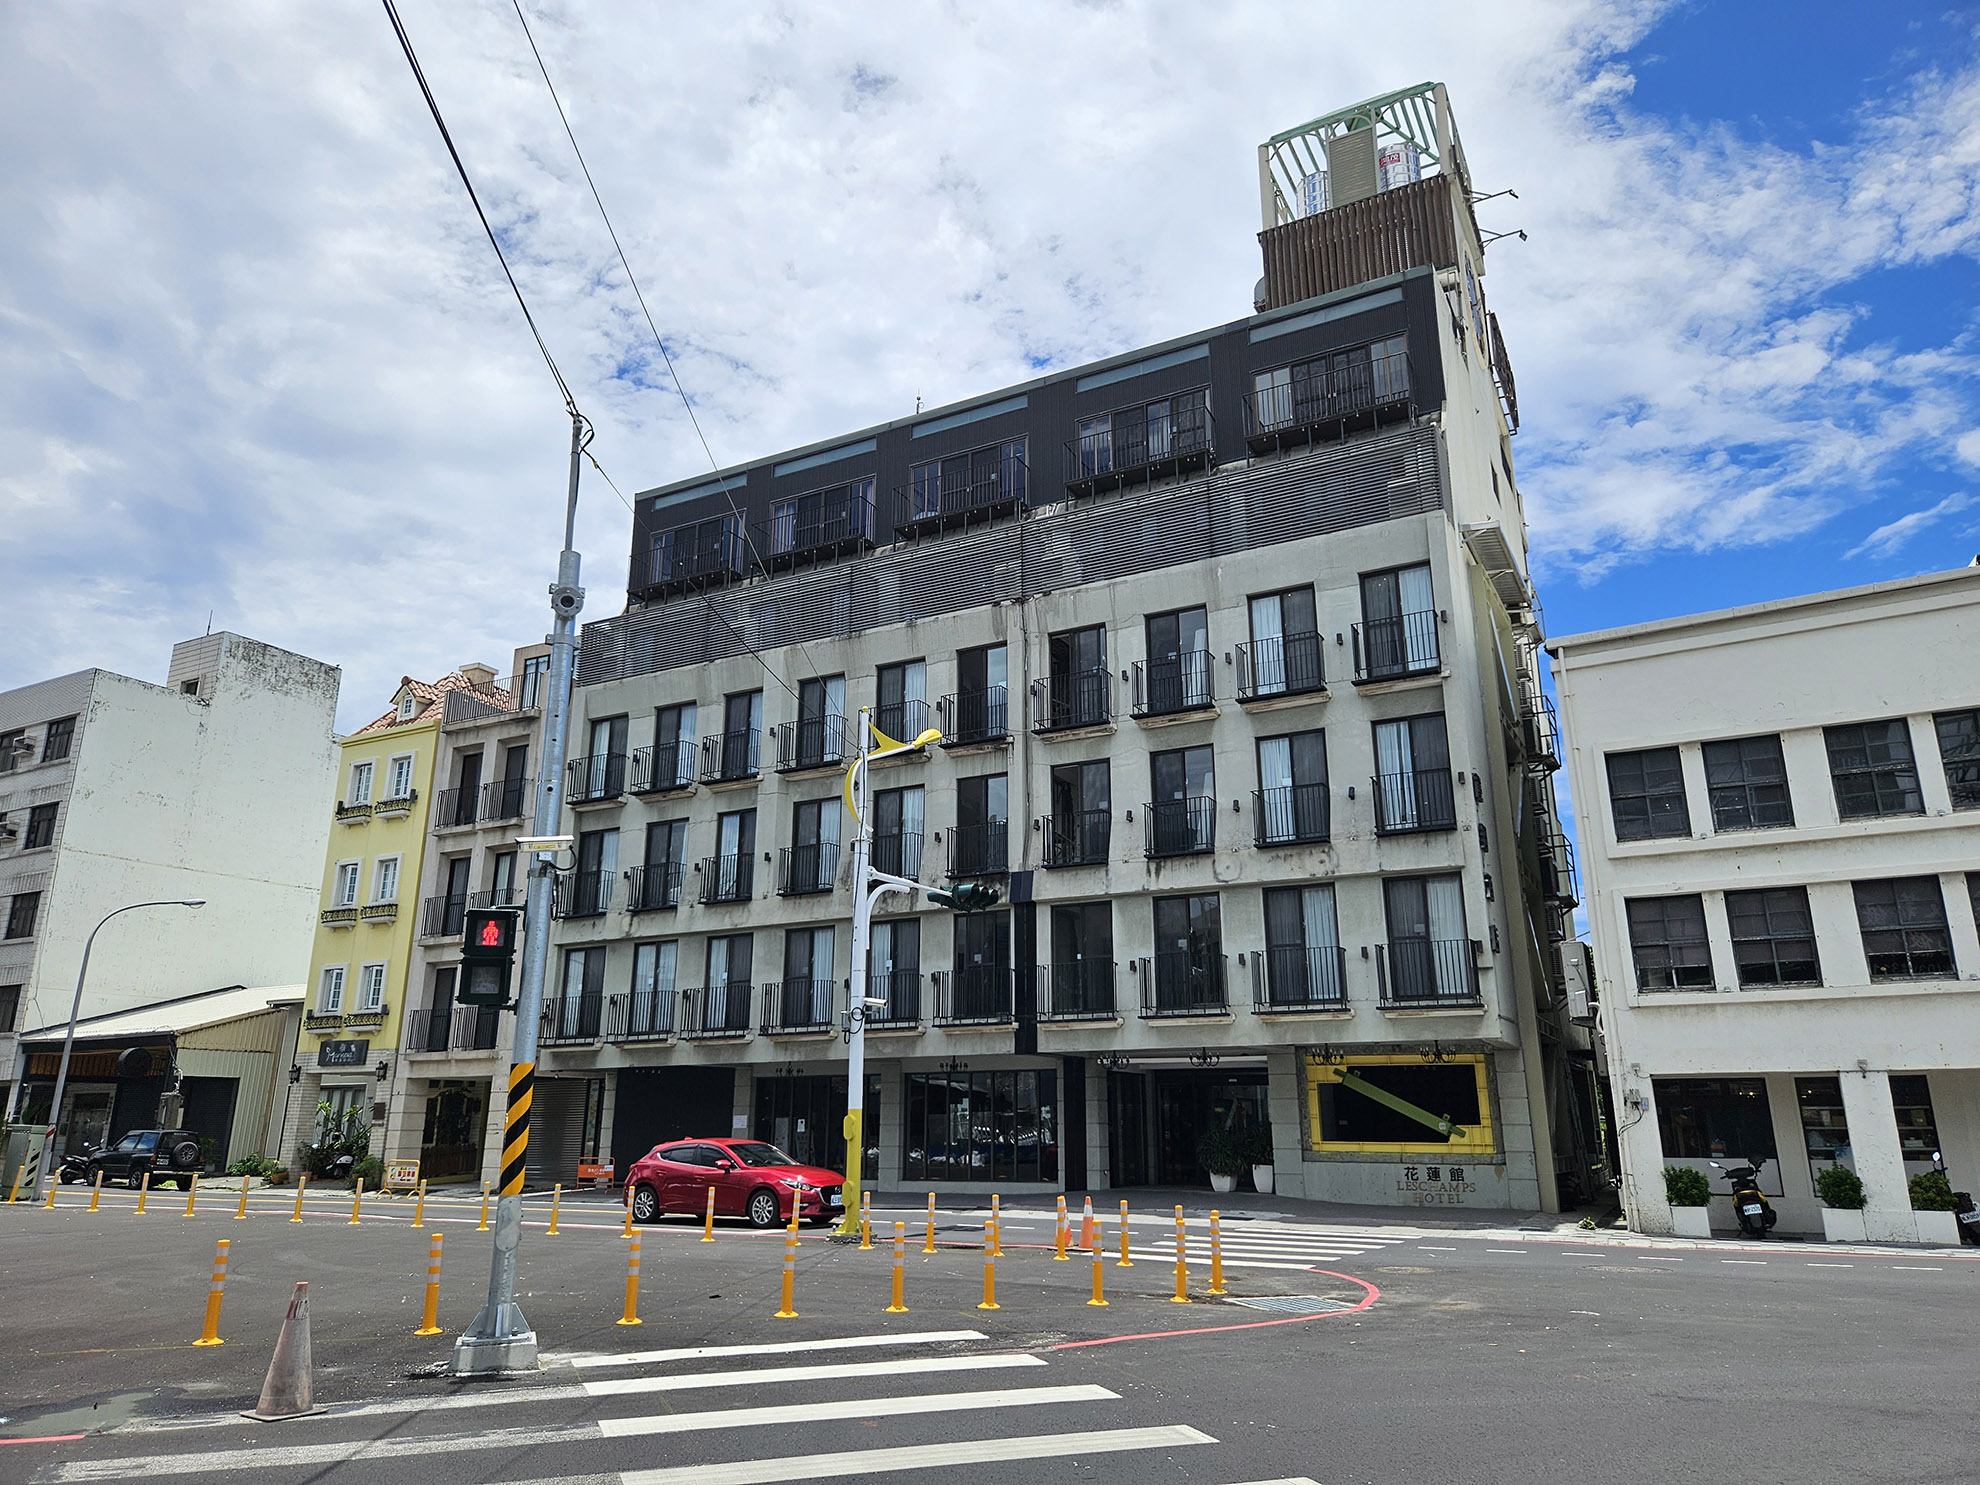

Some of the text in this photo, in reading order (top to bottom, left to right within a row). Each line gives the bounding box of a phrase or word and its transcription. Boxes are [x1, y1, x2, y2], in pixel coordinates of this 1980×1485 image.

[1403, 1166, 1465, 1181] 花蓮館
[1397, 1181, 1476, 1193] LESCHAMPS
[1413, 1192, 1464, 1204] HOTEL
